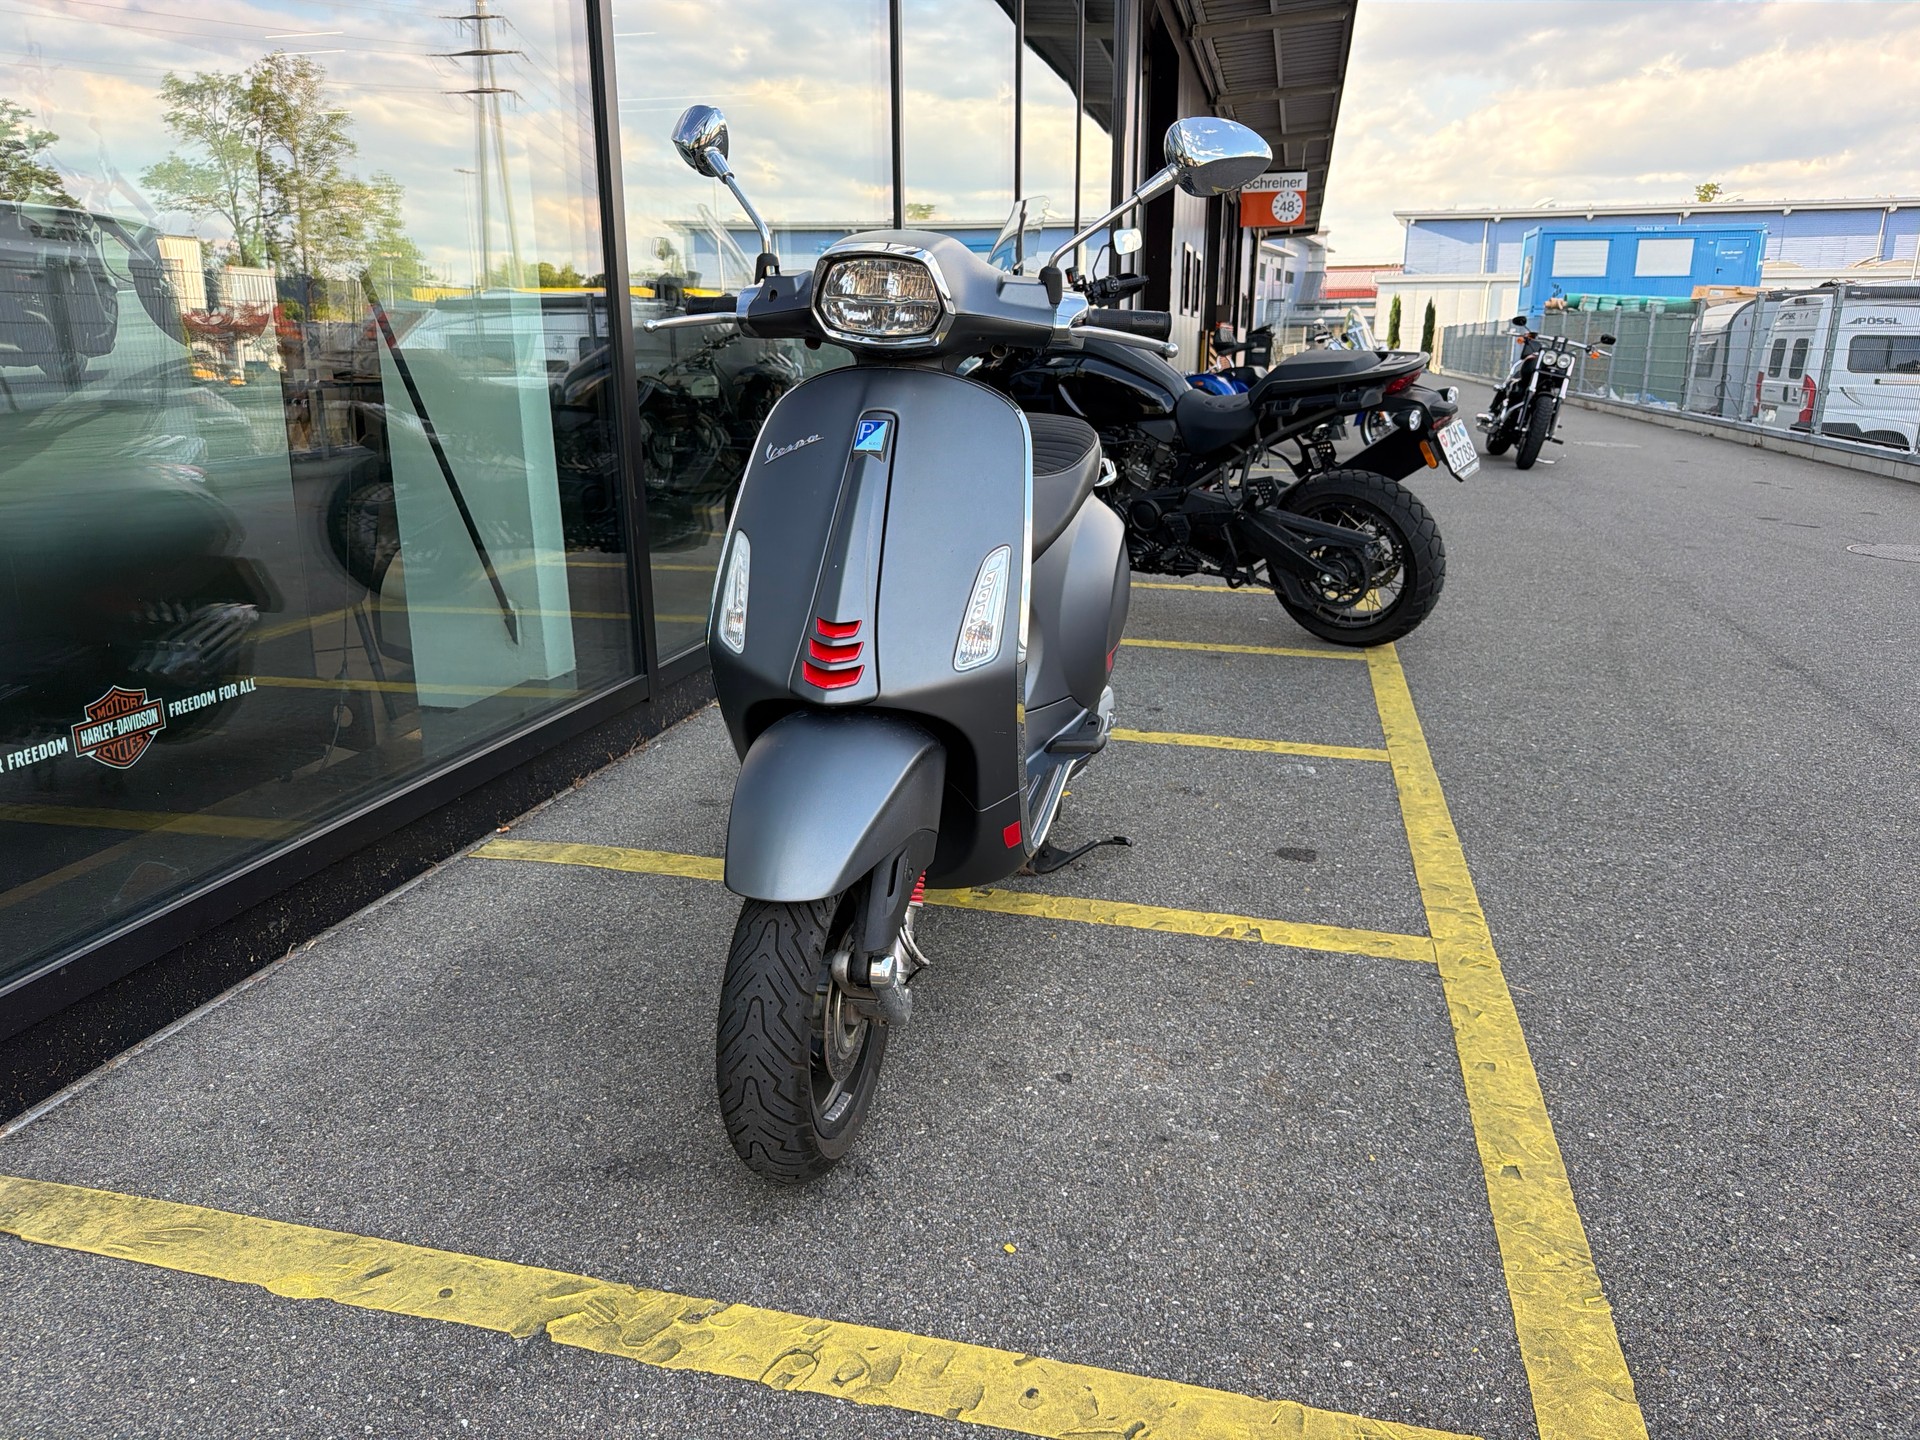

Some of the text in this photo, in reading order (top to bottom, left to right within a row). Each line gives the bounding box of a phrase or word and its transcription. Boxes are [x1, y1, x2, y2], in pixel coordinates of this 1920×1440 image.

[1279, 200, 1295, 213] 48
[1857, 315, 1902, 325] PÖSSL
[1445, 424, 1462, 448] ZH
[1448, 441, 1476, 471] 33788
[96, 695, 139, 718] MOTOR
[168, 677, 257, 718] FREEDOM FOR ALL
[80, 707, 159, 747] HARLEY-DAVIDSON
[6, 737, 69, 771] FREEDOM
[102, 734, 144, 760] CYCLES
